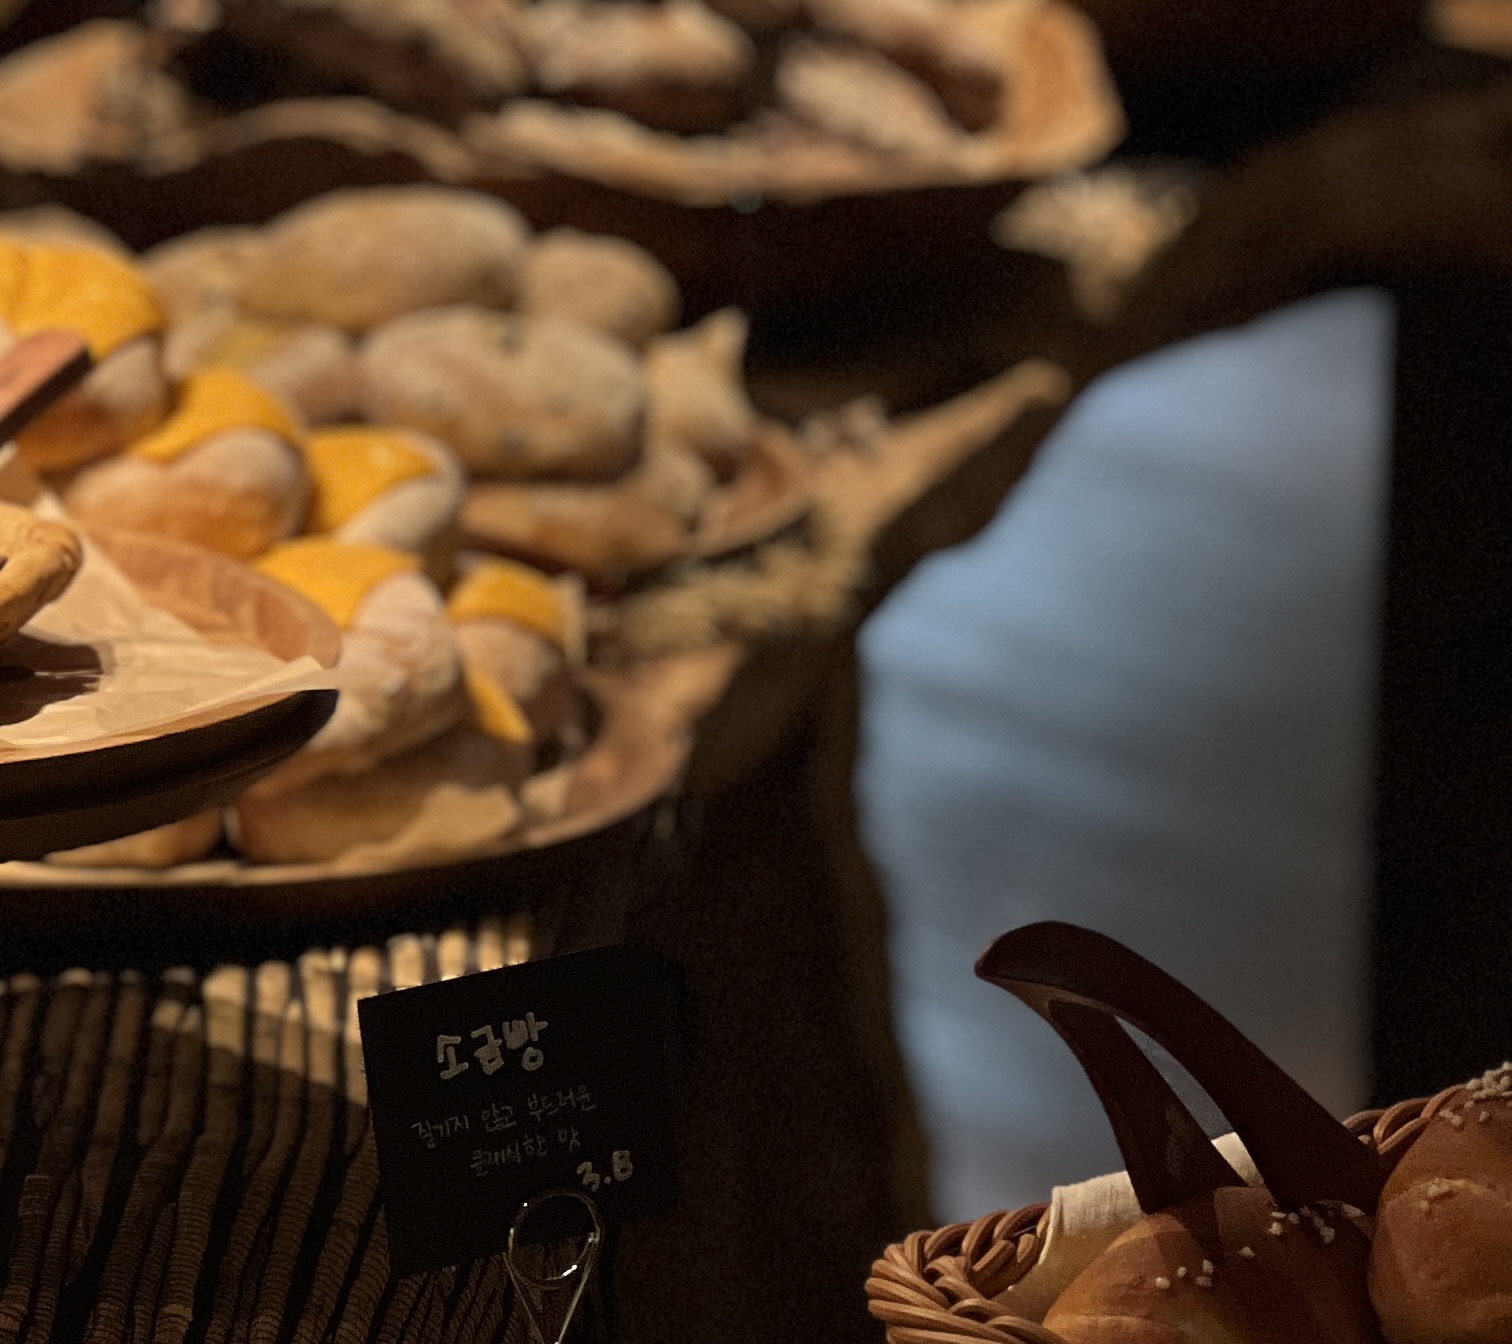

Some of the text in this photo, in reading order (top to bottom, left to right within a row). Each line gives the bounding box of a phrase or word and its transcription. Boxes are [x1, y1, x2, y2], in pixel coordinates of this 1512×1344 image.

[436, 1012, 548, 1080] 소금빵
[411, 1114, 470, 1150] 질기지
[527, 1084, 598, 1122] 부드러운
[576, 1149, 634, 1192] 3.8
